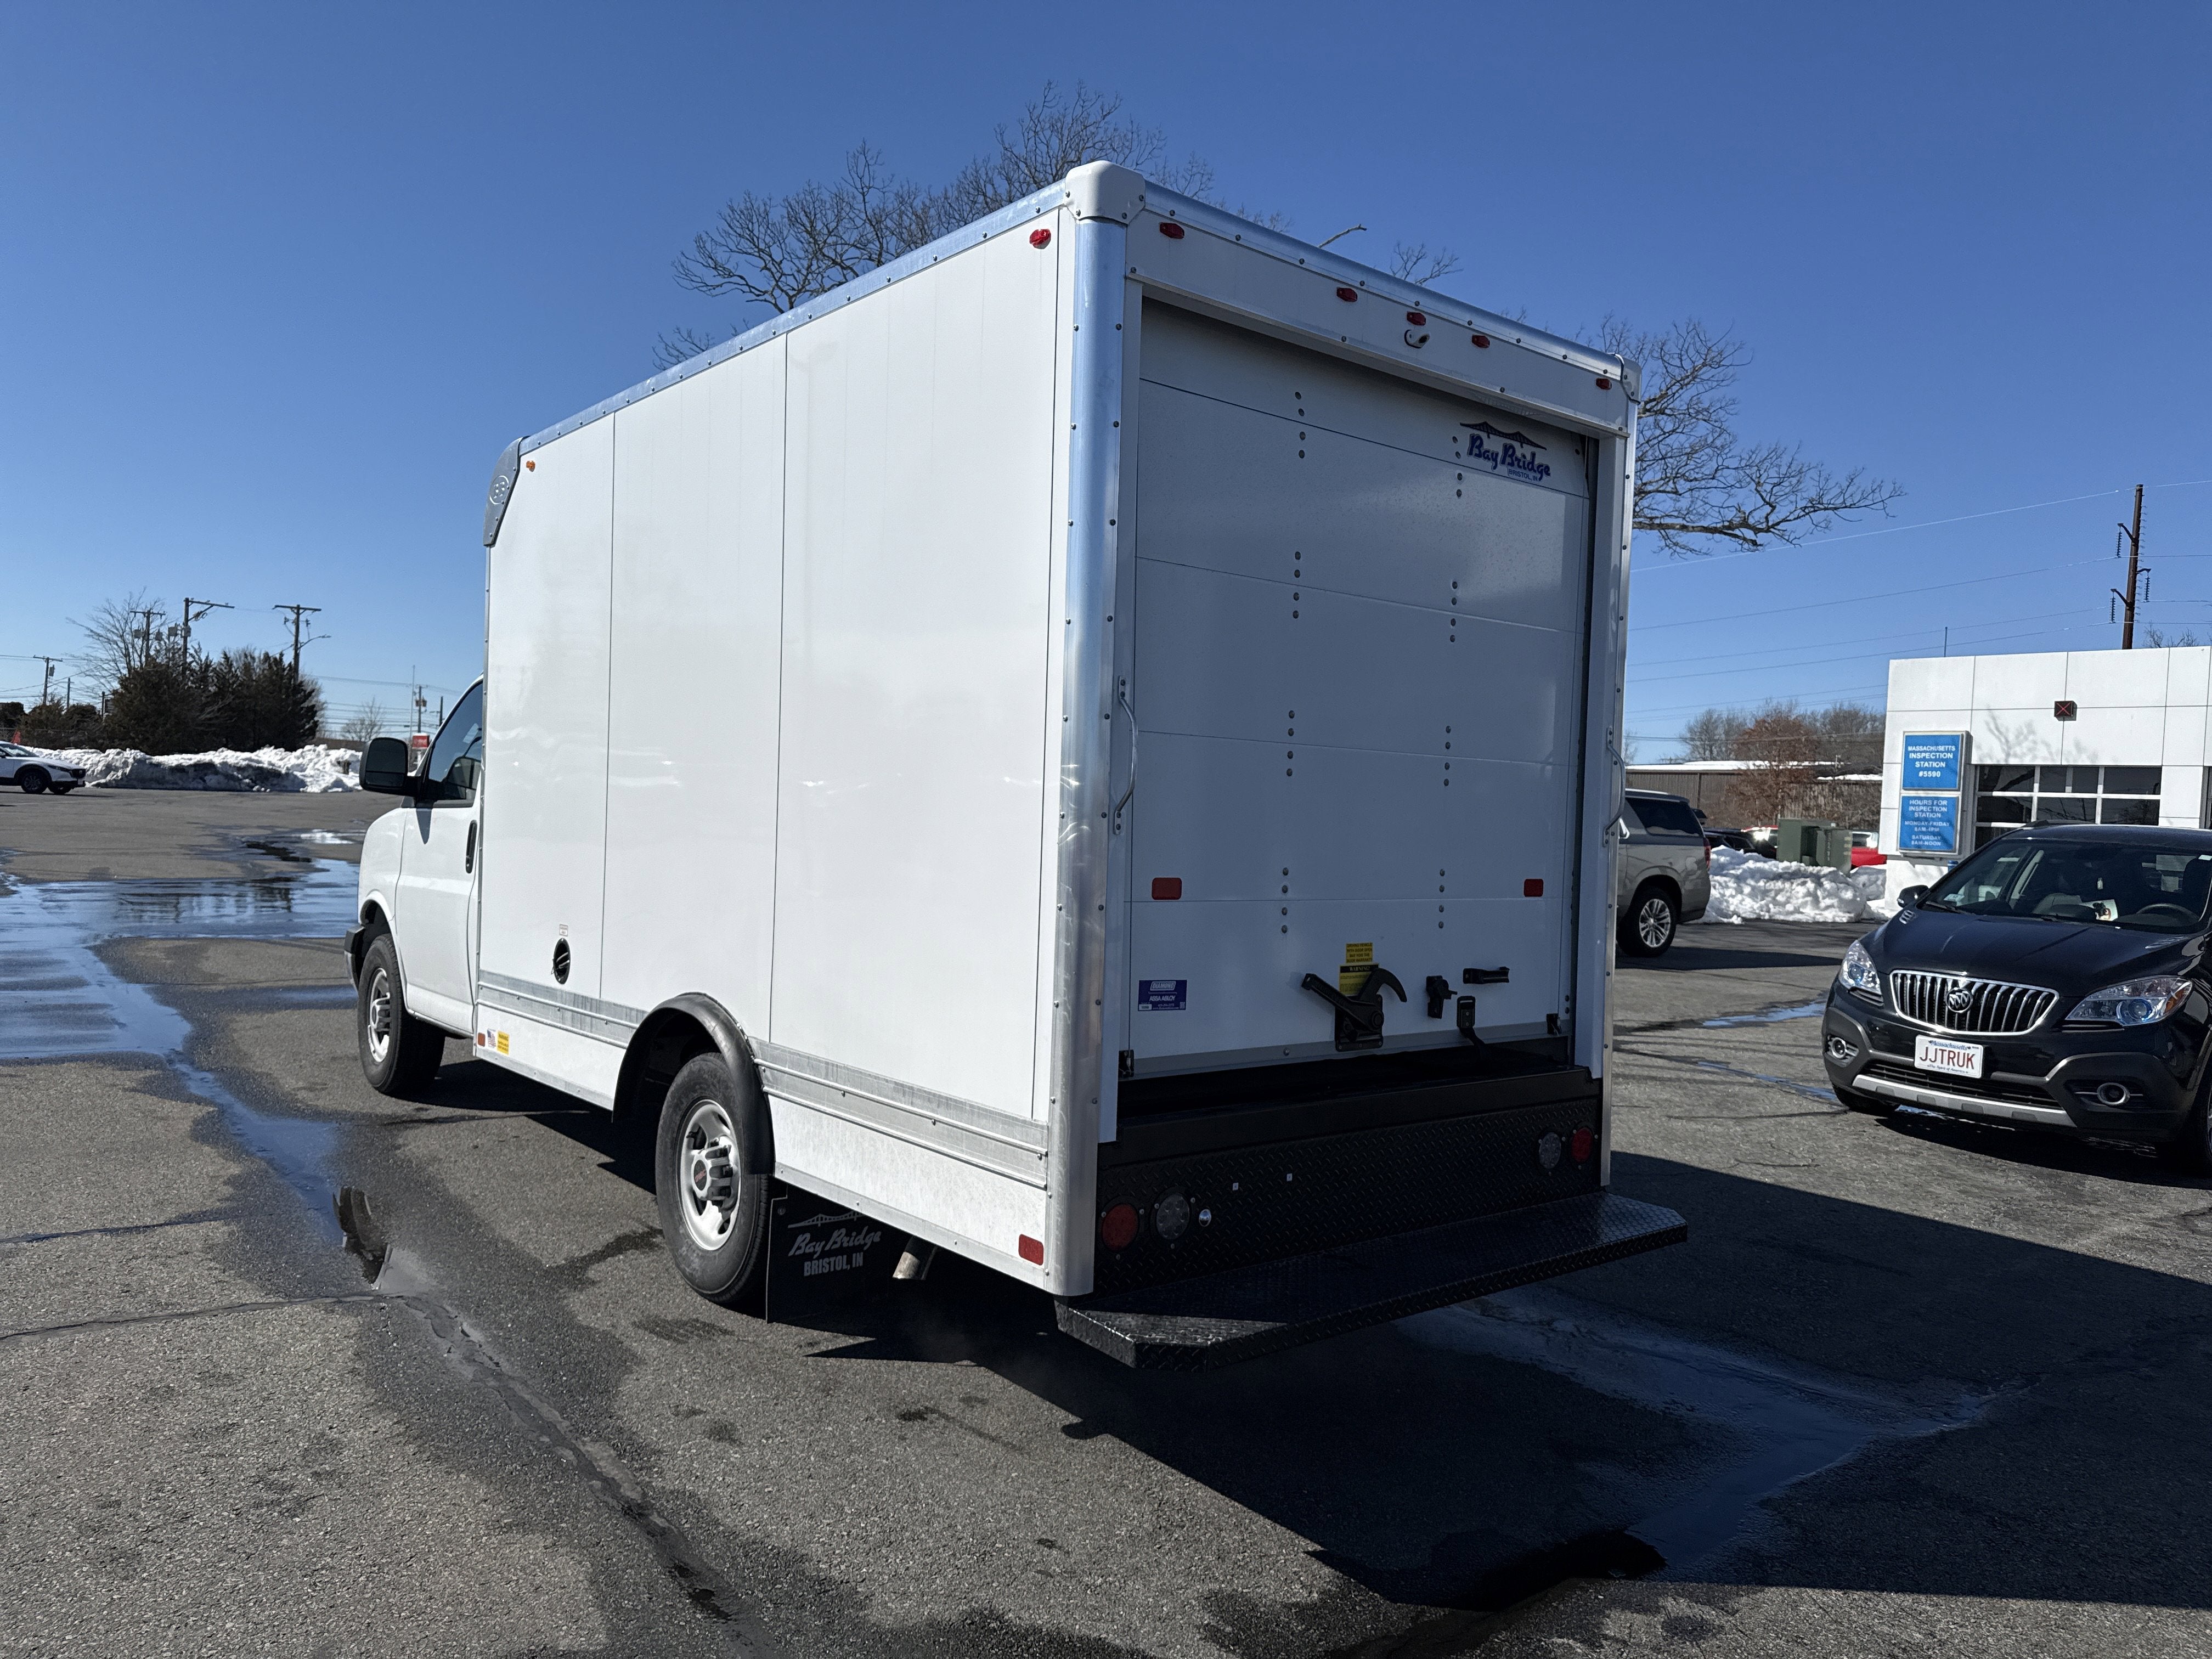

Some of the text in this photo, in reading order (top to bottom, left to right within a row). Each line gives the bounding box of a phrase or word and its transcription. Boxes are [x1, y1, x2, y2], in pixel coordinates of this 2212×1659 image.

[1468, 433, 1551, 481] Bay Bridge
[1509, 469, 1532, 481] BRISTOL,
[1931, 1040, 1968, 1051] Massachusetts
[1919, 1046, 1976, 1070] JJTRUK
[788, 1226, 882, 1259] Bay Bridge
[804, 1252, 864, 1277] BRISTOL, IN
